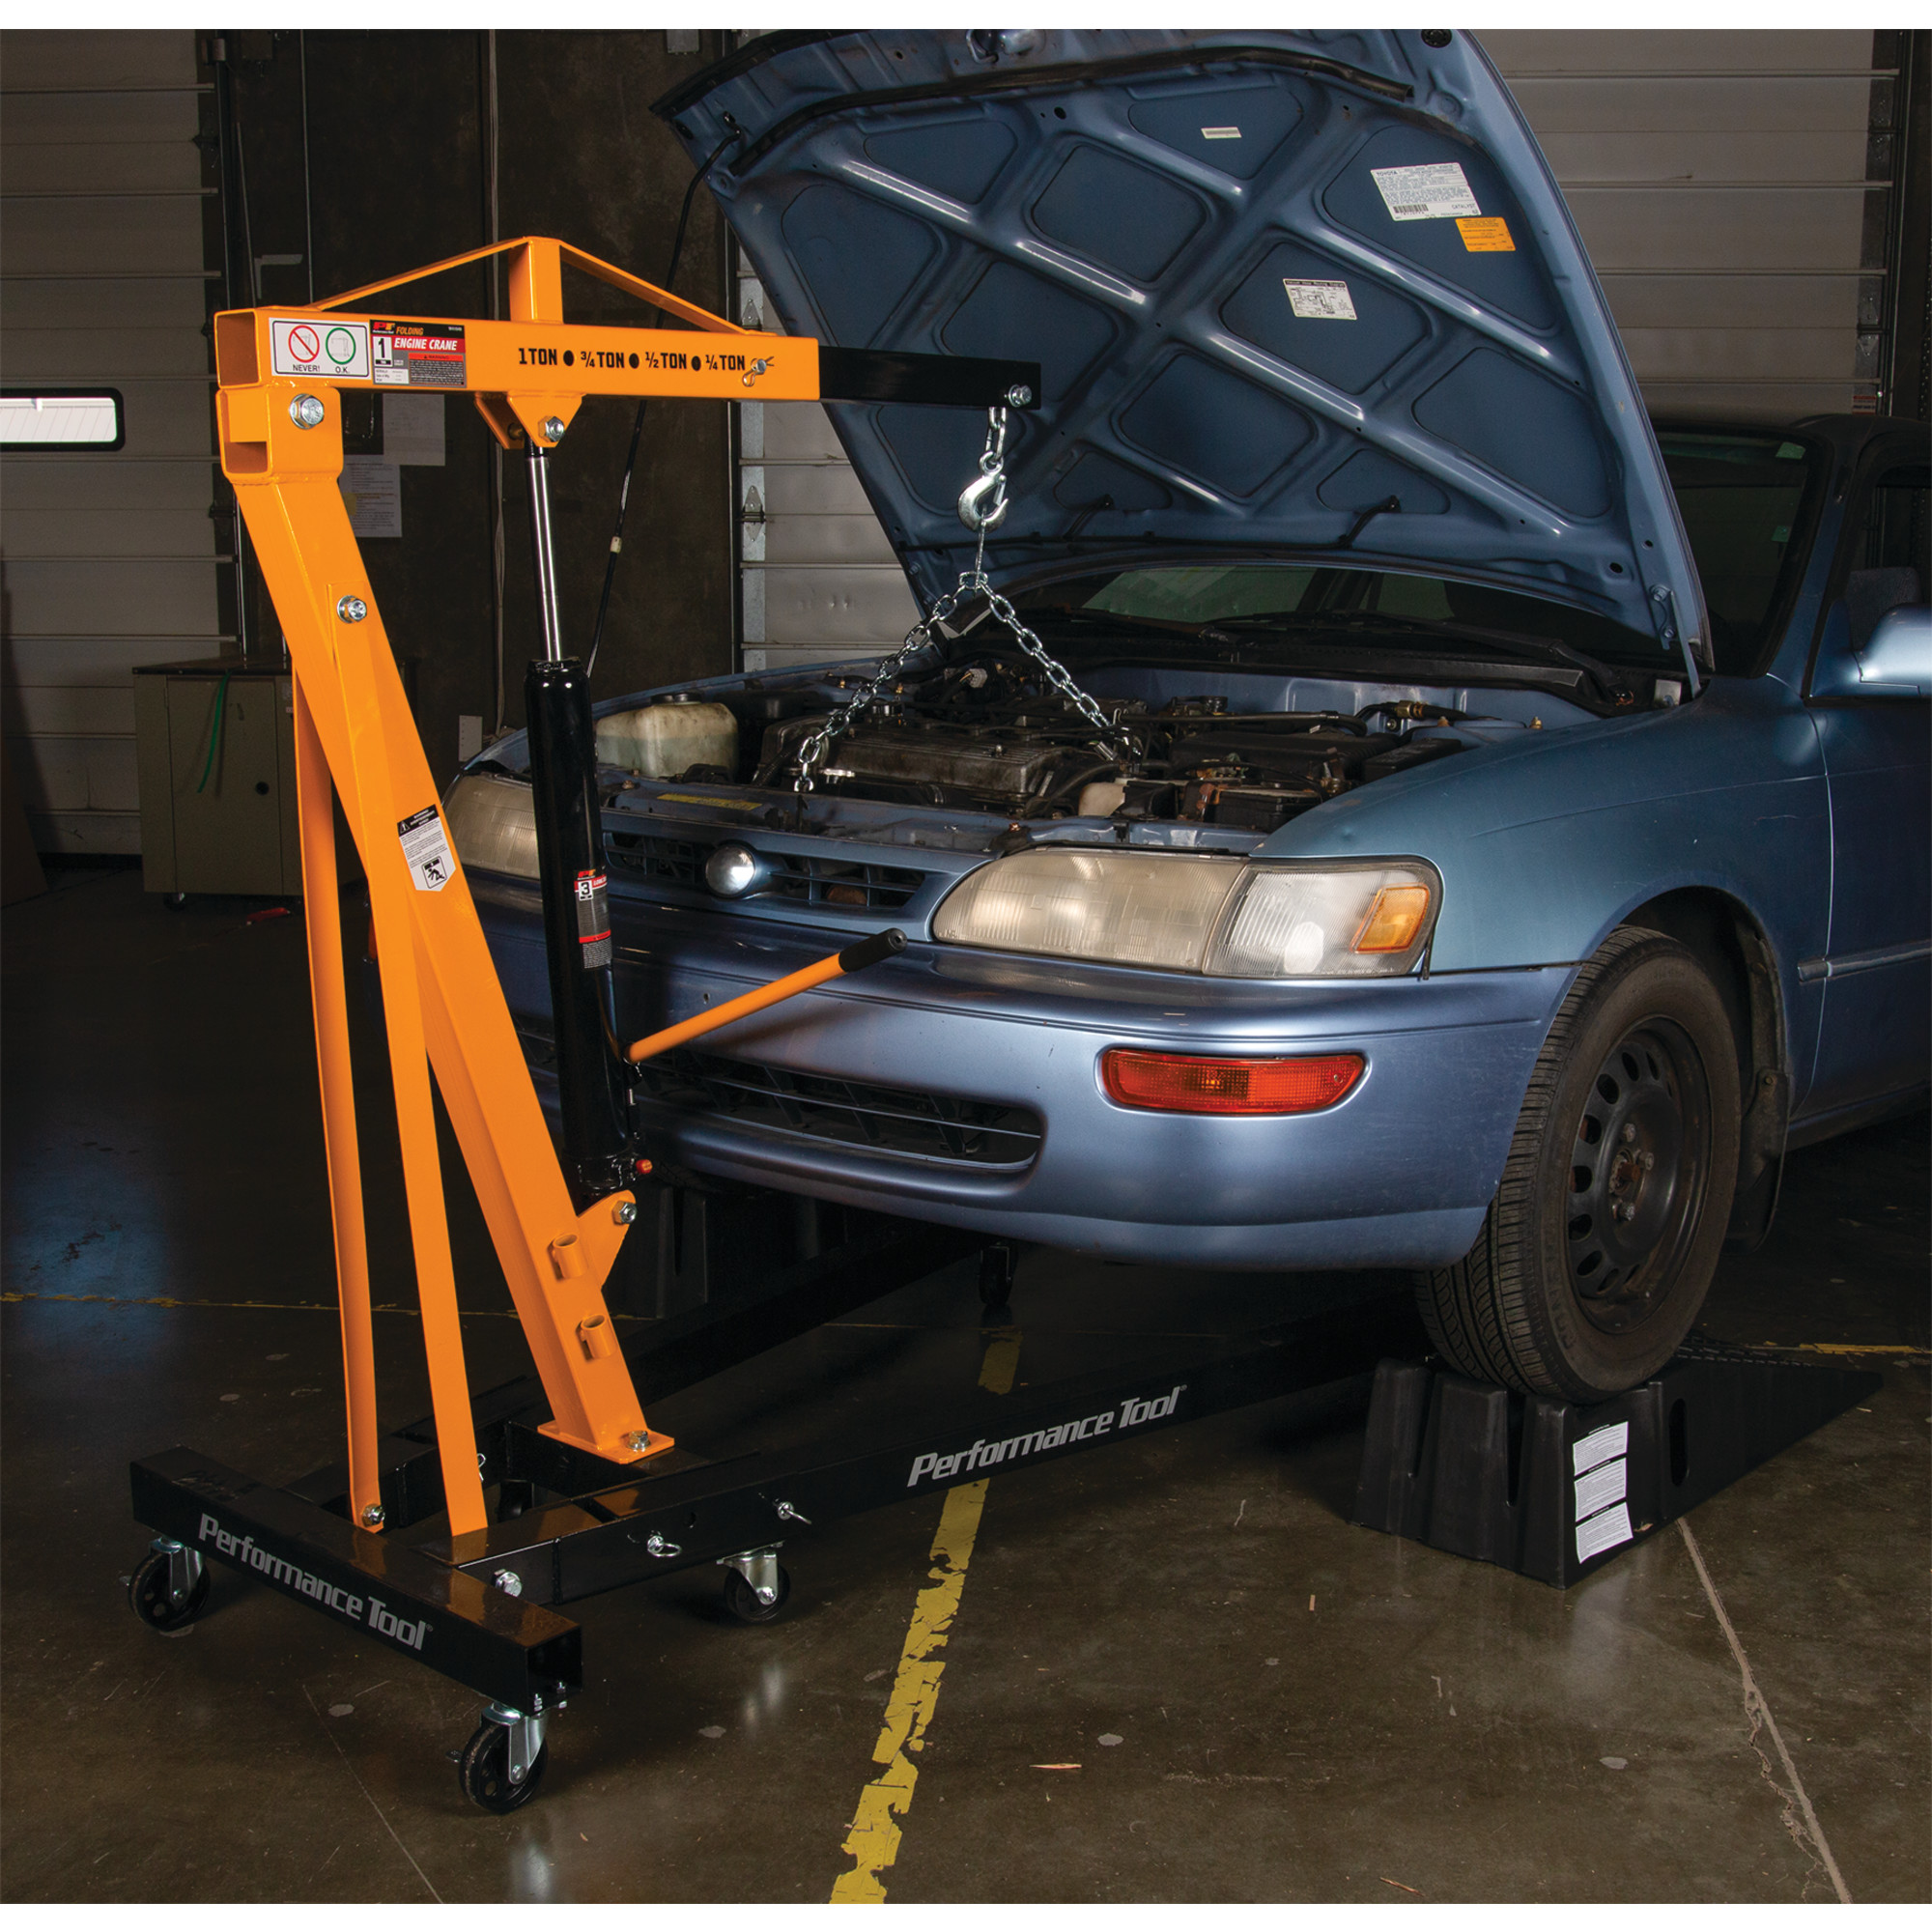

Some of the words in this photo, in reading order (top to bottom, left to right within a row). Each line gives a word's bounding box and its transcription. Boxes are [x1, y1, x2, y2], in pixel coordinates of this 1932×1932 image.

[396, 327, 424, 336] FOLDING
[378, 337, 385, 358] 1
[394, 337, 427, 349] ENGINE
[429, 339, 458, 351] CRANE
[518, 348, 527, 364] 1
[527, 348, 557, 365] TON
[596, 352, 624, 368] TON
[660, 353, 687, 369] TON
[719, 355, 746, 370] TON
[292, 364, 320, 373] NEVER!
[581, 882, 590, 895] 3
[906, 1411, 1115, 1488] Performance
[198, 1513, 363, 1621] Performance
